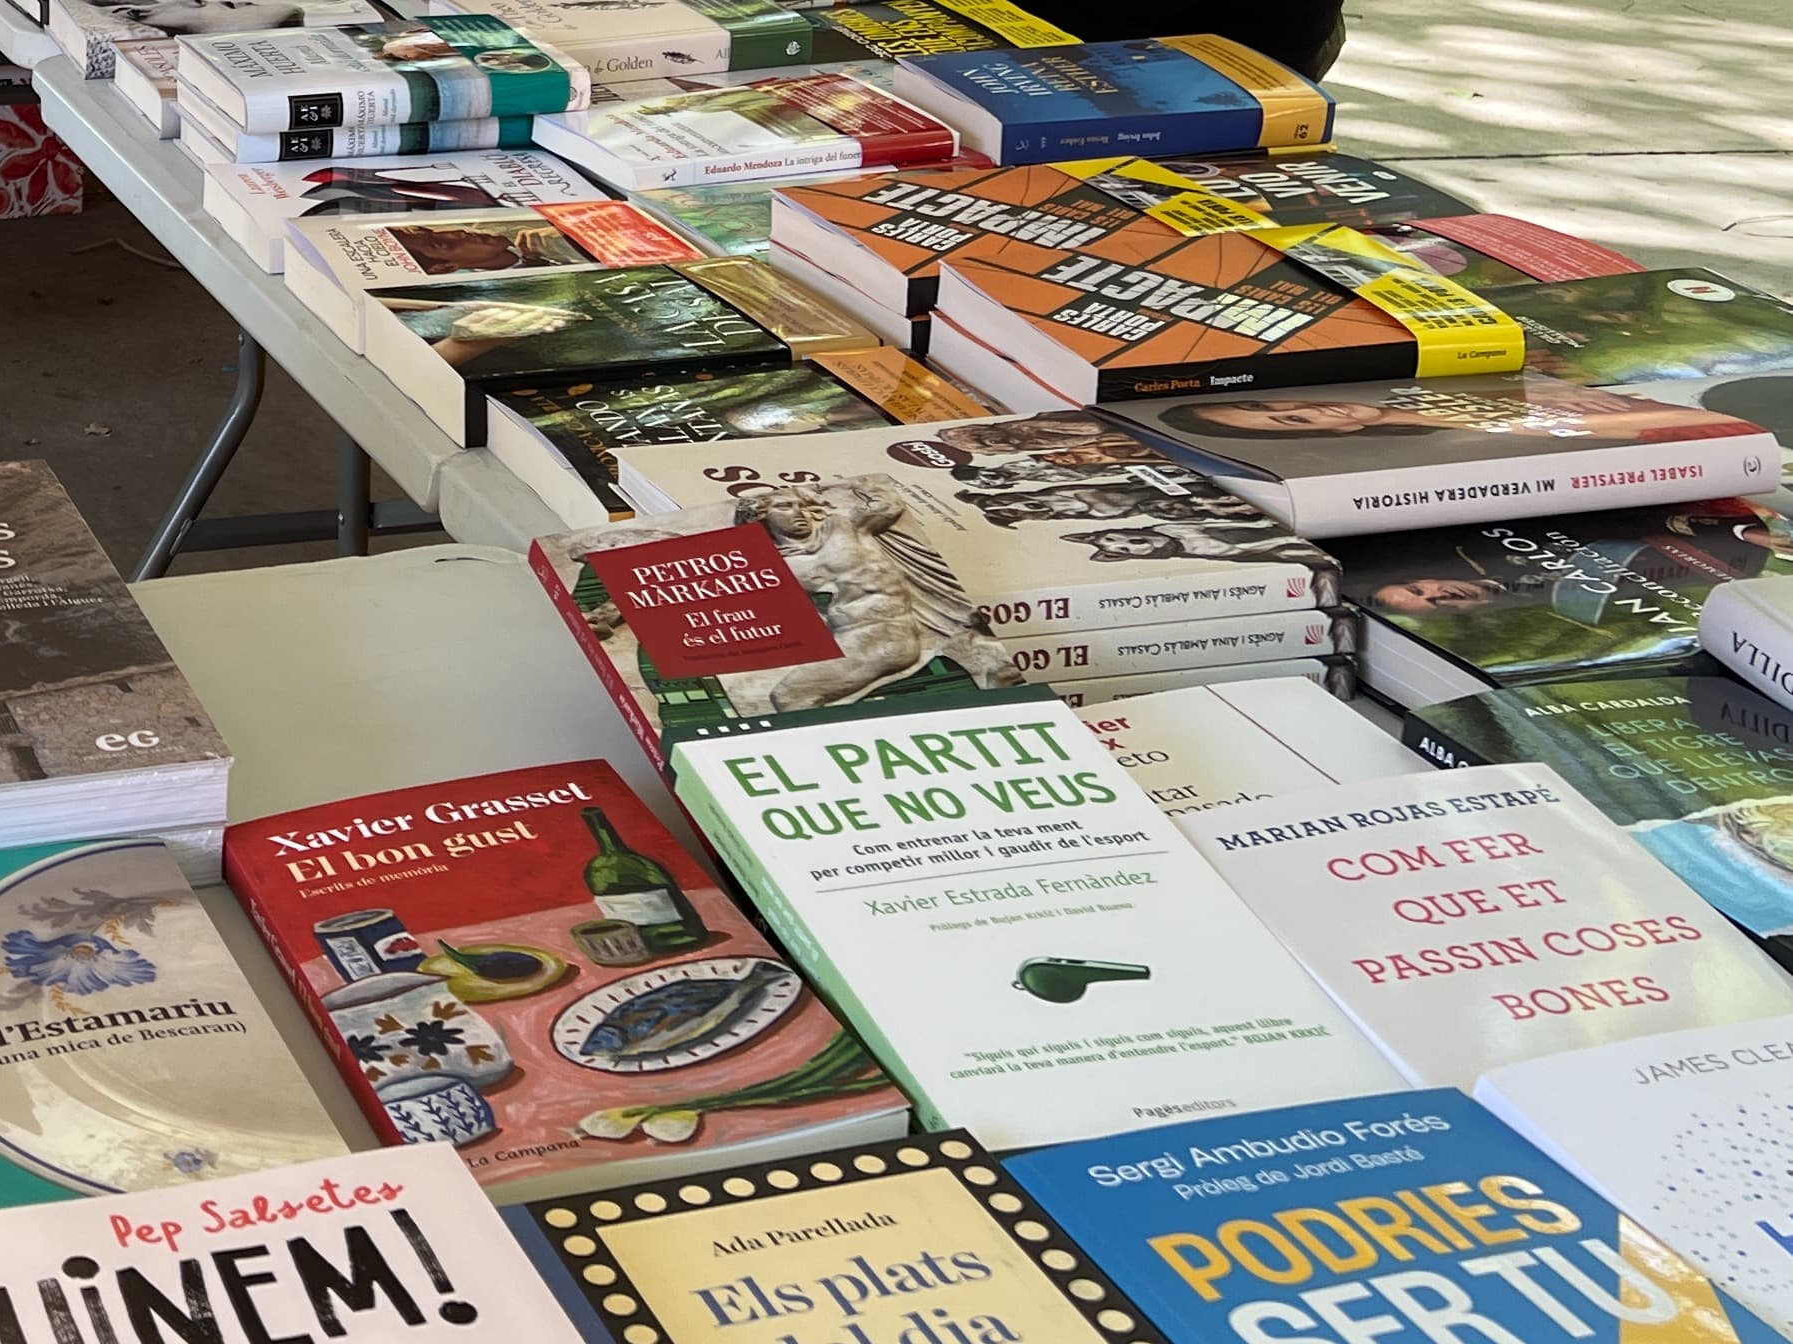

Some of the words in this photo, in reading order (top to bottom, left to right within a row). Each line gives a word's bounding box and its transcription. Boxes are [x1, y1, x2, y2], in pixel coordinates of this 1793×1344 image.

[607, 56, 653, 73] Golden
[705, 161, 742, 175] Eduardo
[744, 157, 783, 172] Mendoza
[784, 156, 795, 167] La
[796, 153, 823, 168] intriga
[825, 152, 837, 163] del
[1275, 161, 1390, 205] VENIR
[862, 183, 1108, 251] IMPACTE
[905, 217, 974, 244] PORTA
[871, 223, 959, 252] CARLES
[1134, 379, 1169, 394] Carles
[1171, 377, 1201, 392] Porta
[1209, 372, 1254, 387] Impacte
[1433, 481, 1531, 504] VERDADERA
[1534, 477, 1555, 493] MI
[1570, 469, 1645, 489] PREYSLER
[1649, 465, 1704, 483] ISABEL
[1352, 490, 1429, 512] HISTORIA
[631, 550, 749, 586] PETROS
[1481, 525, 1618, 595] CARLOS
[625, 568, 782, 610] MÀRKARIS
[1038, 597, 1070, 620] EL
[685, 610, 709, 629] El
[713, 605, 756, 624] frau
[977, 603, 1032, 625] GOS
[683, 630, 705, 649] és
[708, 626, 727, 643] el
[730, 620, 782, 641] futur
[1523, 701, 1578, 718] ALBA
[1579, 694, 1693, 712] CARDALDA
[1586, 717, 1701, 738] LIBERA
[1601, 742, 1648, 757] EL
[1644, 732, 1744, 752] TIGRE
[723, 754, 820, 797] EL
[824, 721, 1073, 784] PARTIT
[1608, 758, 1685, 779] QUE
[1683, 748, 1793, 770] LLEVAS
[1665, 768, 1793, 795] DENTRO
[266, 810, 415, 856] Xavier
[425, 780, 593, 826] Grasset
[761, 798, 882, 841] QUE
[882, 786, 968, 825] NO
[970, 771, 1118, 812] VEUS
[1216, 816, 1346, 852] MARIAN
[1352, 799, 1449, 830] ROJAS
[1452, 782, 1563, 816] ESTAPÉ
[285, 854, 341, 885] El
[349, 836, 433, 872] bon
[446, 817, 539, 860] gust
[809, 863, 841, 883] per
[844, 855, 925, 878] competir
[927, 847, 982, 867] millor
[985, 845, 994, 858] i
[997, 839, 1055, 862] gaudir
[1057, 835, 1080, 850] de
[1082, 828, 1151, 852] l'esport
[852, 839, 893, 857] Com
[896, 829, 970, 852] entrenar
[972, 825, 991, 843] la
[994, 823, 1033, 839] teva
[1036, 818, 1084, 836] ment
[1326, 844, 1444, 883] COM
[1448, 831, 1545, 864] FER
[299, 880, 355, 901] Escrits
[356, 875, 378, 889] de
[380, 861, 449, 884] memòria
[864, 893, 940, 917] Xavier
[945, 882, 1031, 906] Estrada
[1036, 867, 1160, 895] Fernàndez
[1390, 889, 1499, 925] QUE
[1499, 878, 1568, 909] ET
[1351, 936, 1542, 986] PASSIN
[1542, 915, 1705, 958] COSES
[1491, 975, 1672, 1022] BONES
[45, 1036, 102, 1058] mica
[106, 1030, 136, 1047] de
[140, 1019, 248, 1044] Bescaran)
[1086, 1153, 1188, 1191] Sergi
[1188, 1124, 1348, 1172] Ambudio
[1347, 1109, 1453, 1146] Forés
[712, 1234, 766, 1258] Ada
[766, 1210, 898, 1247] Parellada
[1146, 1173, 1583, 1304] PODRIES
[690, 1273, 815, 1329] Els
[816, 1248, 994, 1318] plats
[1456, 1238, 1681, 1342] TU
